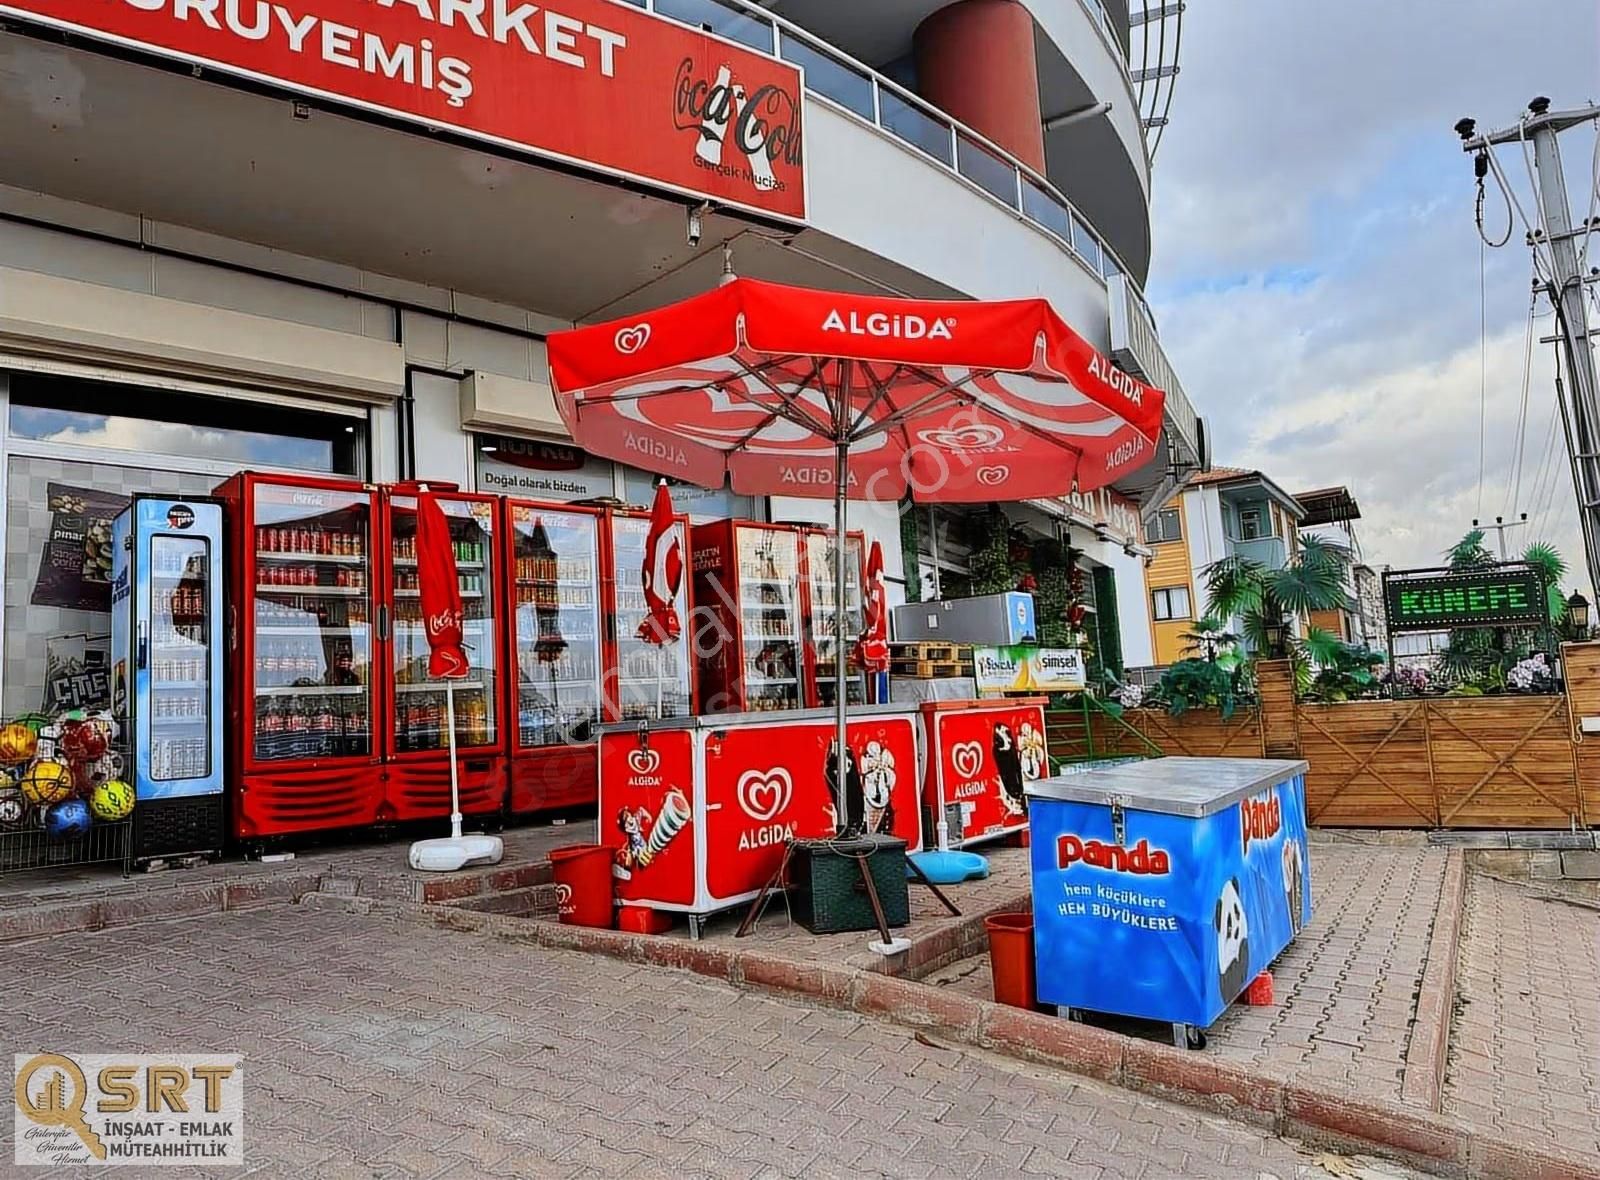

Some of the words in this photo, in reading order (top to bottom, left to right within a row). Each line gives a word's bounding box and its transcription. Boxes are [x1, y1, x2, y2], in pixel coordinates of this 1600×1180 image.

[693, 155, 741, 177] Gerçek
[743, 169, 786, 192] Mucize
[485, 472, 518, 488] Doğal
[519, 476, 552, 490] olarak
[553, 480, 587, 494] bizden
[1063, 882, 1092, 896] hem
[1097, 884, 1167, 908] küçüklere
[1058, 902, 1087, 916] HEM
[1092, 902, 1178, 931] BÜYÜKLERE
